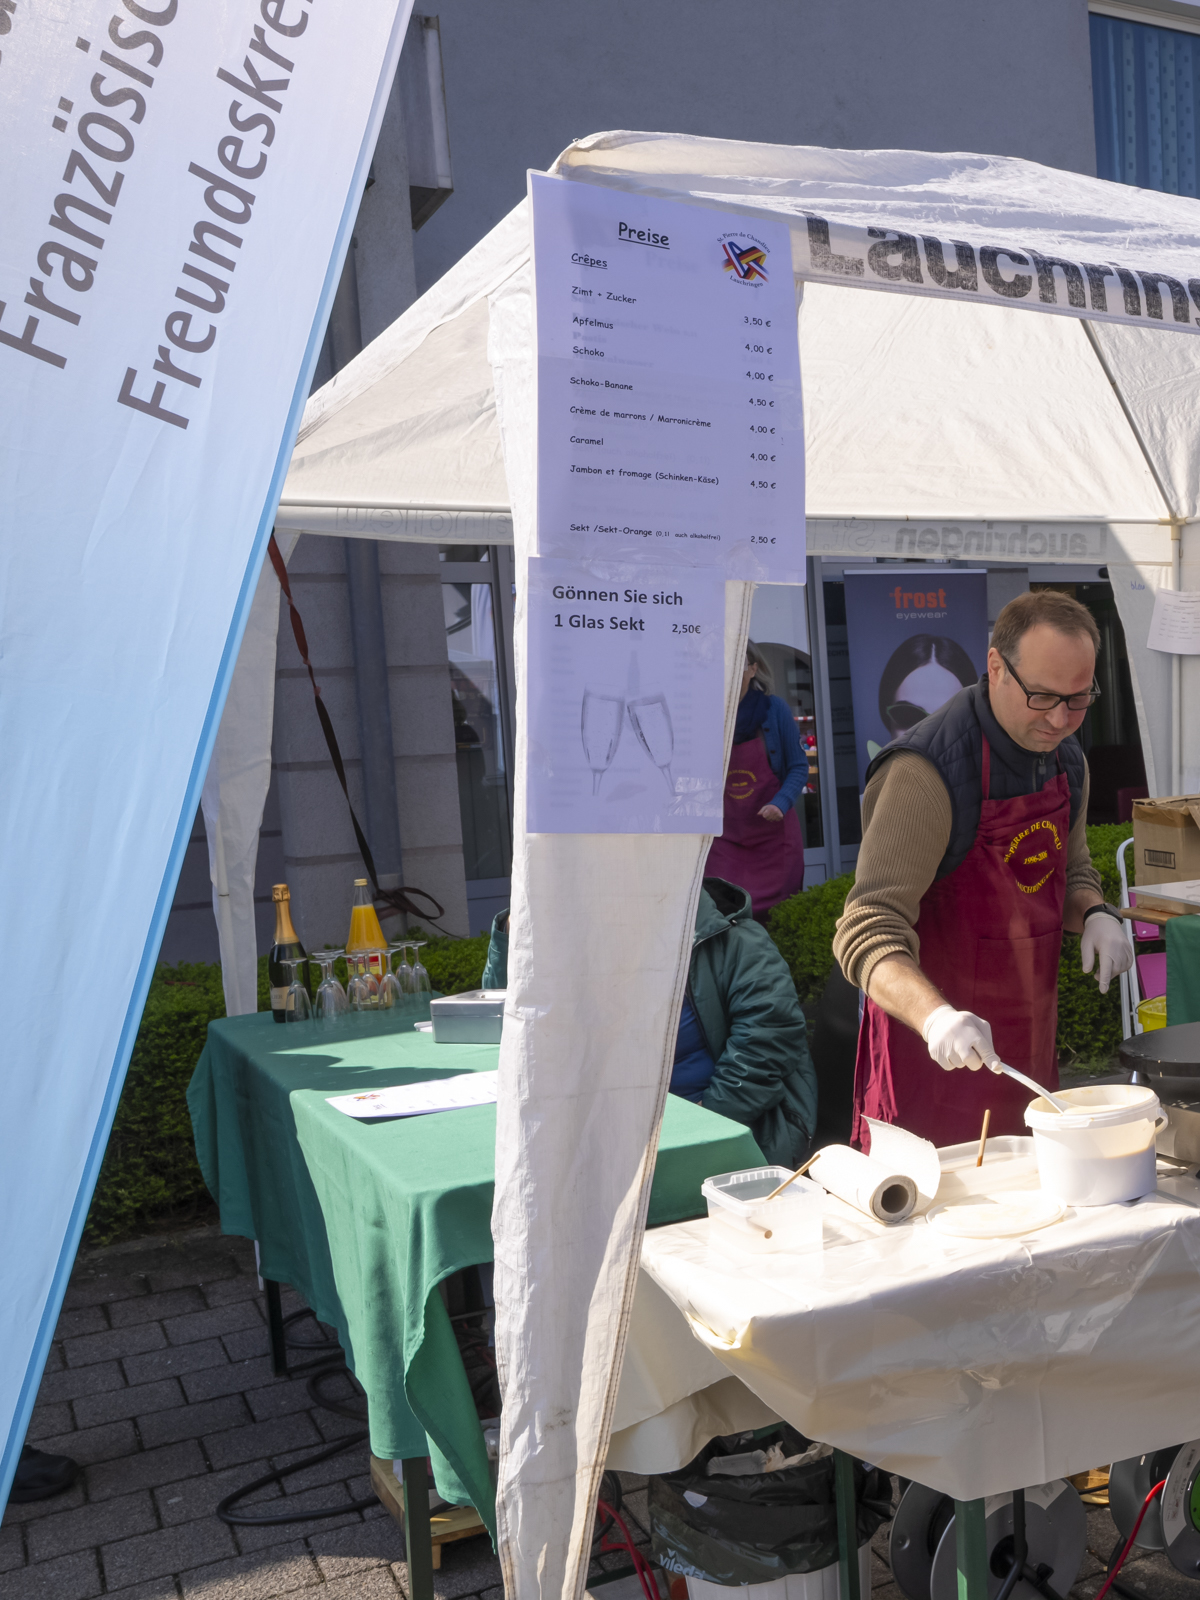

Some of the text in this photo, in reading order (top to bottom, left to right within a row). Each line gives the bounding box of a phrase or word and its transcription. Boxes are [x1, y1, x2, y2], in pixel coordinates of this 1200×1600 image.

[117, 0, 314, 430] Freundeskre
[618, 221, 670, 249] Preise
[722, 231, 738, 239] Pierre
[571, 253, 608, 269] Crêpes
[571, 285, 593, 297] Zimt
[606, 291, 637, 304] Zucker
[572, 316, 614, 330] Apfelmus
[743, 315, 771, 328] 3,50 €
[572, 345, 605, 358] Schoko
[745, 343, 773, 355] 4,00 €
[745, 370, 774, 382] 4,00 €
[570, 376, 633, 391] Schoko-Banane
[749, 397, 775, 408] 4,50 €
[570, 405, 596, 417] Crème
[599, 408, 610, 417] de
[613, 411, 647, 421] marrons
[657, 415, 711, 428] Marronicrème
[750, 425, 776, 435] 4,00 €
[570, 435, 604, 446] Caramel
[750, 452, 776, 462] 4,00 €
[570, 464, 719, 485] Jambon et fromage (Schinken-Käse)
[750, 479, 776, 490] 4,50 €
[570, 523, 590, 533] Sekt
[750, 535, 776, 545] 2,50 €
[552, 585, 683, 606] Gönnen Sie sich
[893, 586, 947, 609] frost
[896, 610, 948, 621] eyewear
[554, 613, 701, 635] 1 Glas Sekt 2,50€
